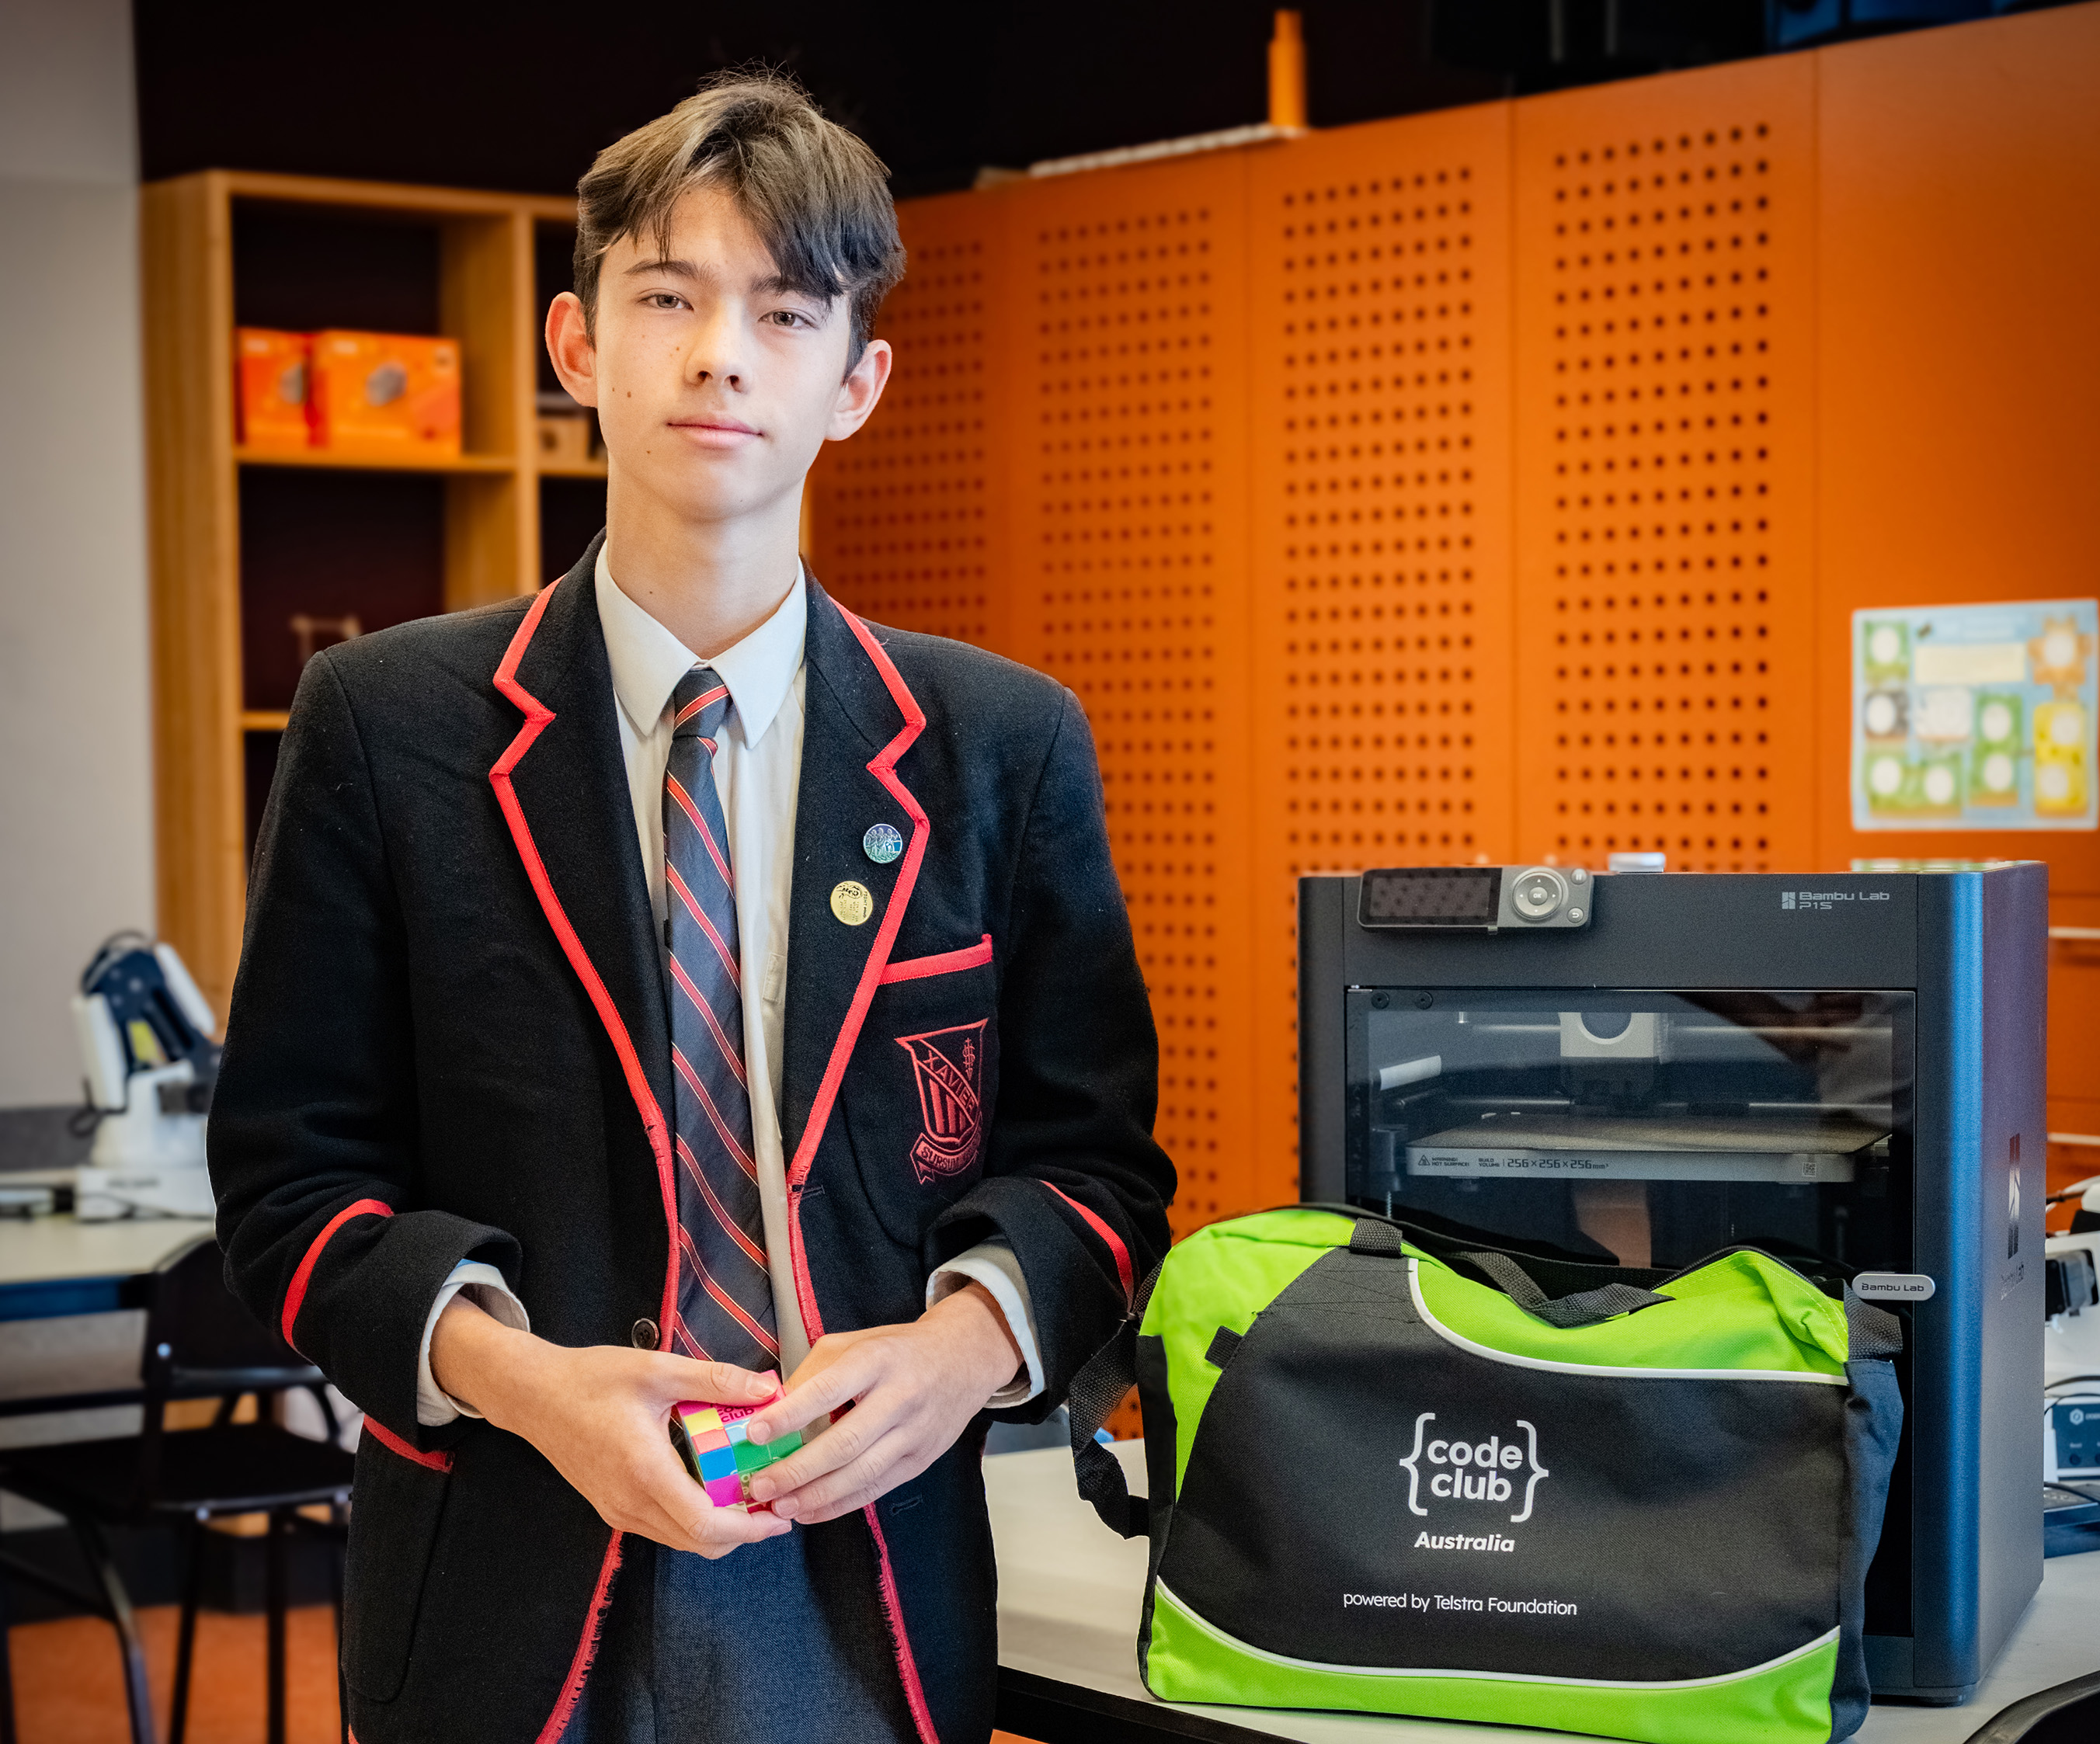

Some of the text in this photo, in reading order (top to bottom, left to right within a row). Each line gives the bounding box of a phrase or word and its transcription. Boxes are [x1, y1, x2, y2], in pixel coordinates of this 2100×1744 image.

[1799, 891, 1890, 901] Bambu Lab
[1799, 902, 1832, 910] P1S
[922, 1049, 975, 1111] XAVIER
[1862, 1283, 1900, 1291] Bambu
[721, 1407, 755, 1423] club
[1427, 1436, 1523, 1470] code
[1431, 1468, 1512, 1502] club
[1414, 1531, 1515, 1552] Australia
[1344, 1593, 1577, 1615] powered by Telstra Foundation
